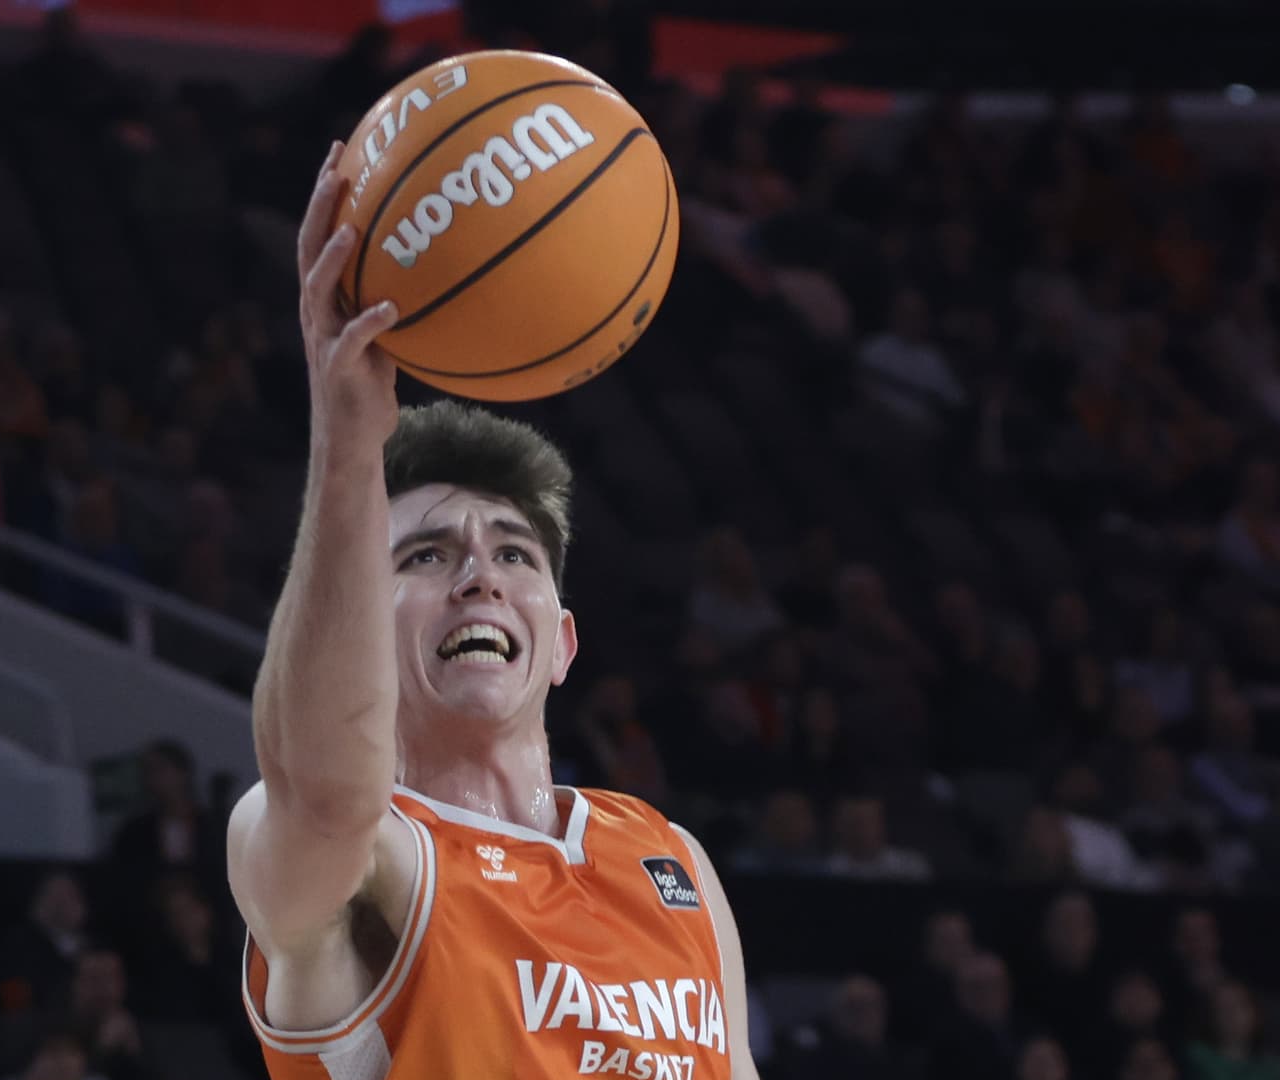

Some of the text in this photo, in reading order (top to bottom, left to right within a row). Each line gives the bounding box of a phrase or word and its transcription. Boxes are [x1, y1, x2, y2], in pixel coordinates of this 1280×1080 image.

[380, 102, 596, 269] Wilson
[481, 867, 518, 883] hummel
[654, 870, 677, 889] liga
[515, 958, 726, 1056] VALENCIA
